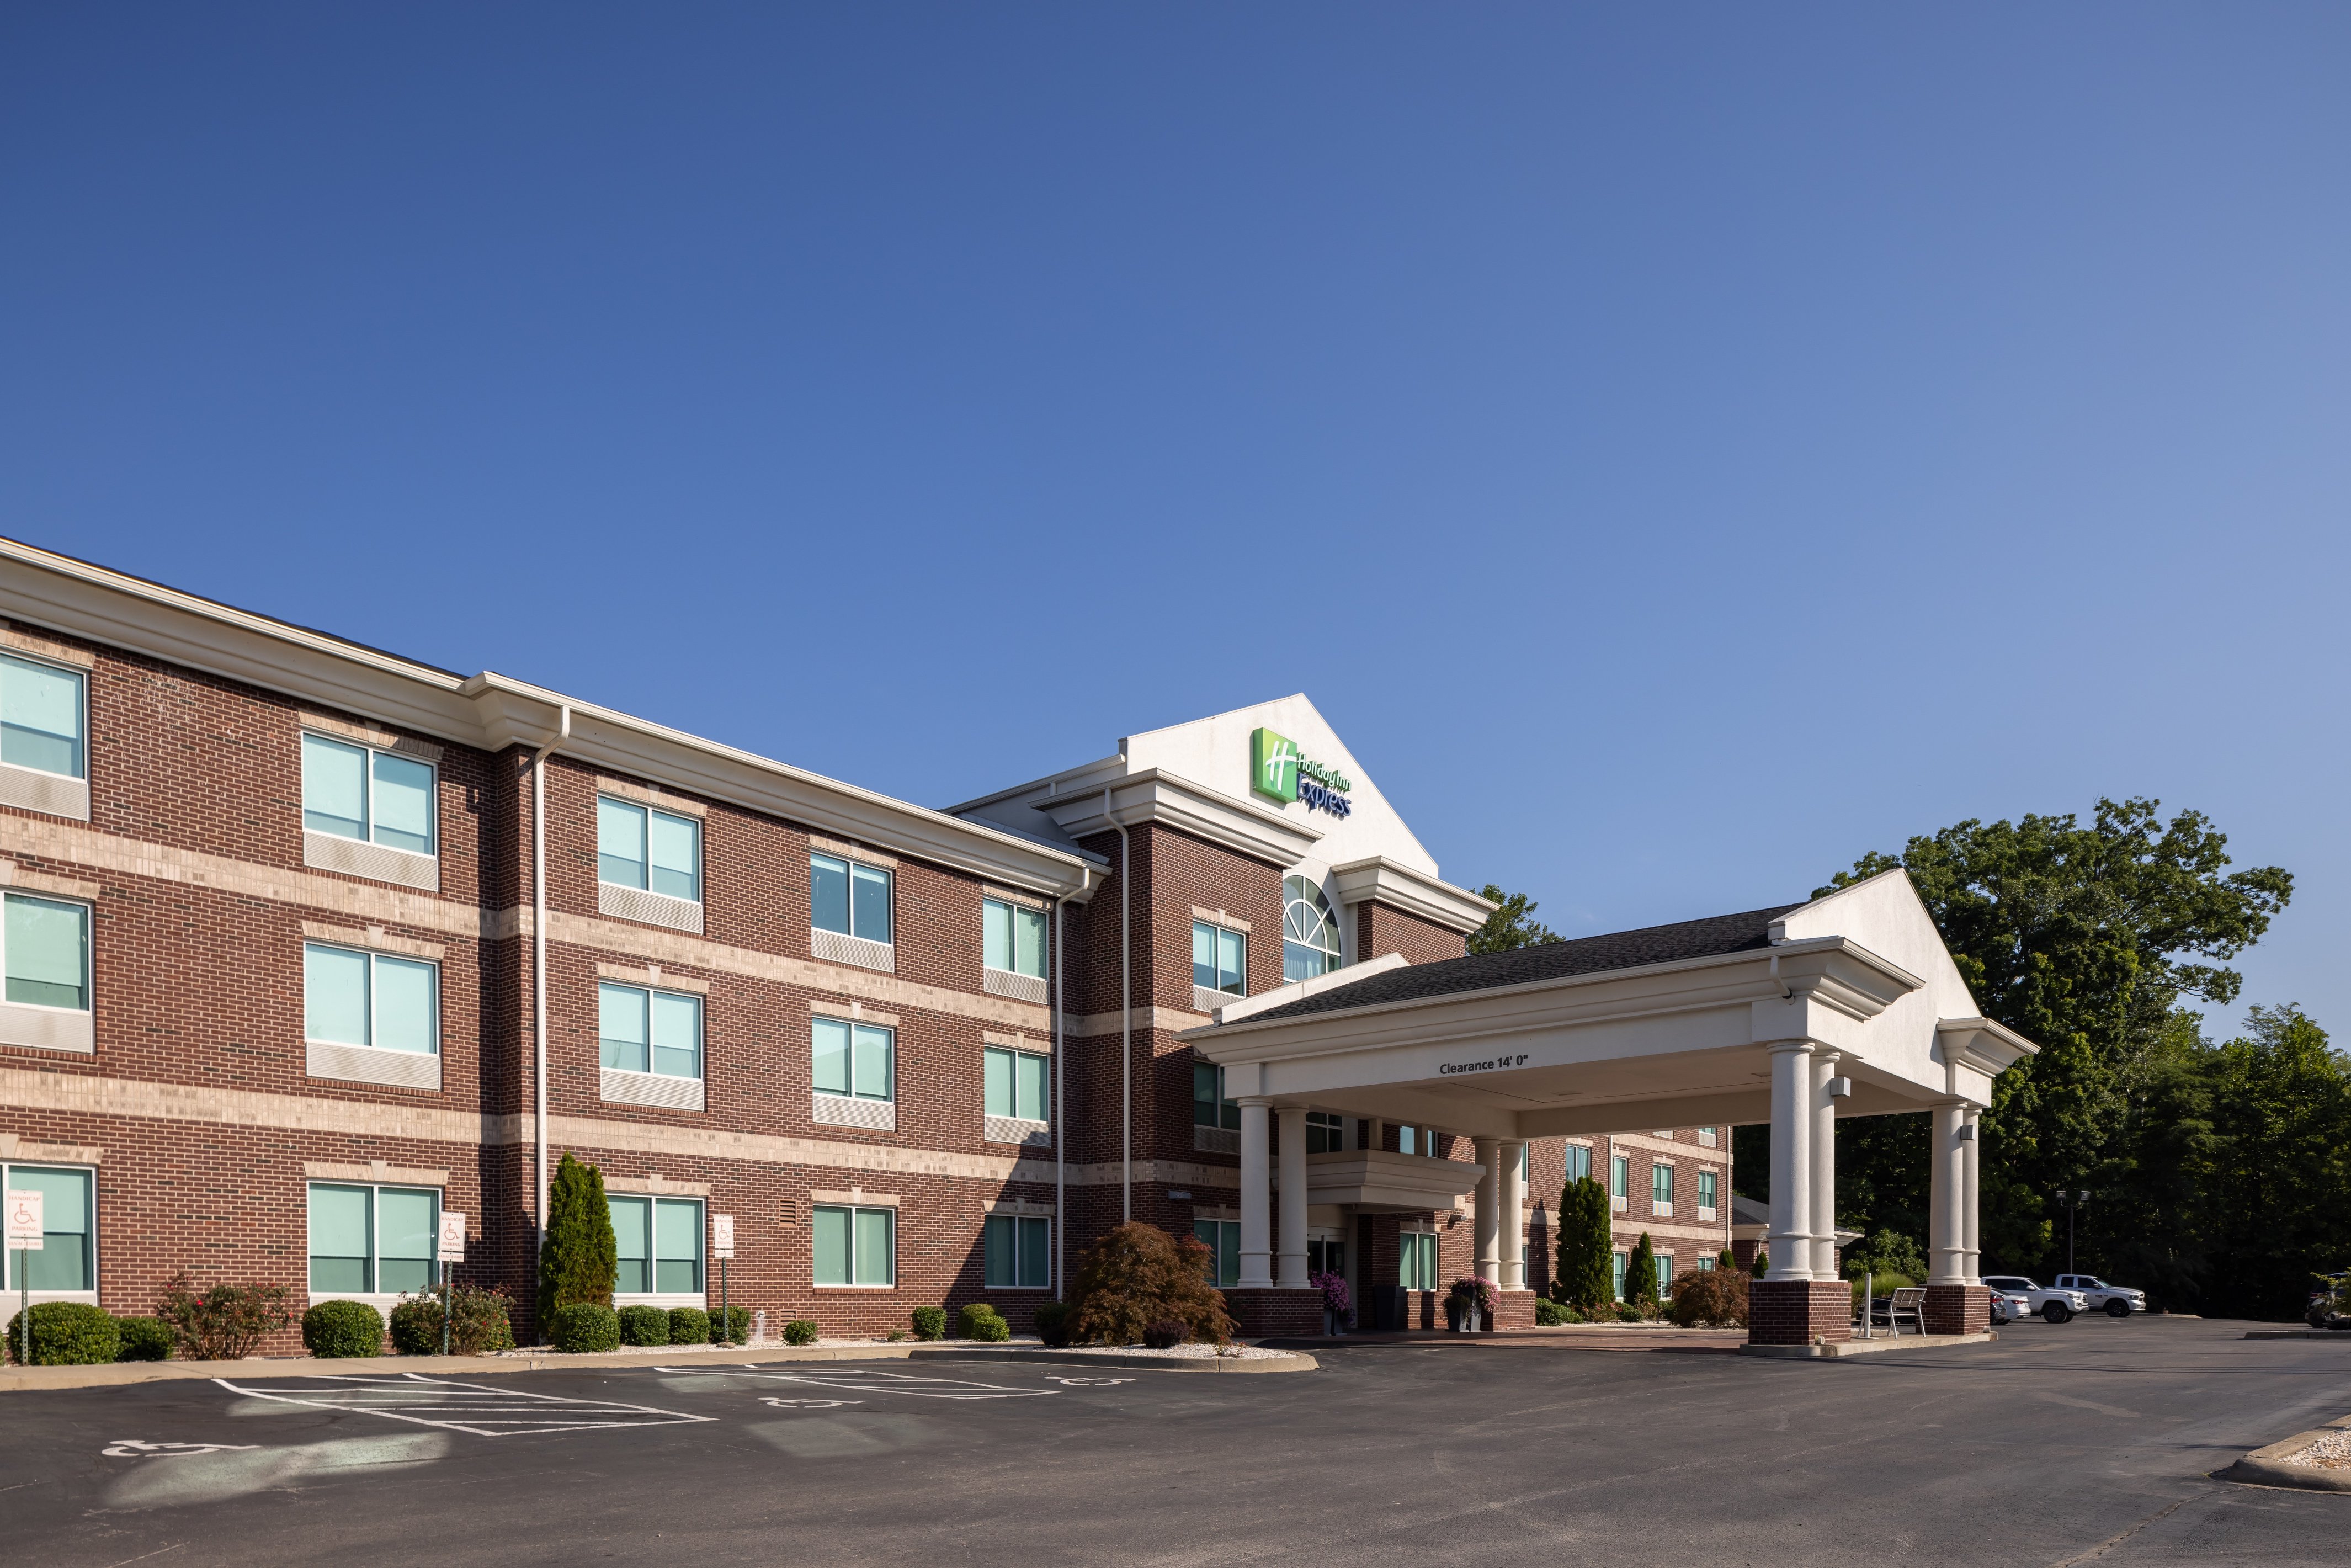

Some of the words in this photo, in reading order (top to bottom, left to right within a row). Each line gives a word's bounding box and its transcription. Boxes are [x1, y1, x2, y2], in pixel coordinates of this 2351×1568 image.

[1297, 752, 1336, 787] Holiday
[1336, 770, 1352, 791] Inn
[1297, 773, 1352, 817] Express
[1440, 1061, 1494, 1075] Clearance
[1497, 1056, 1513, 1068] 14'
